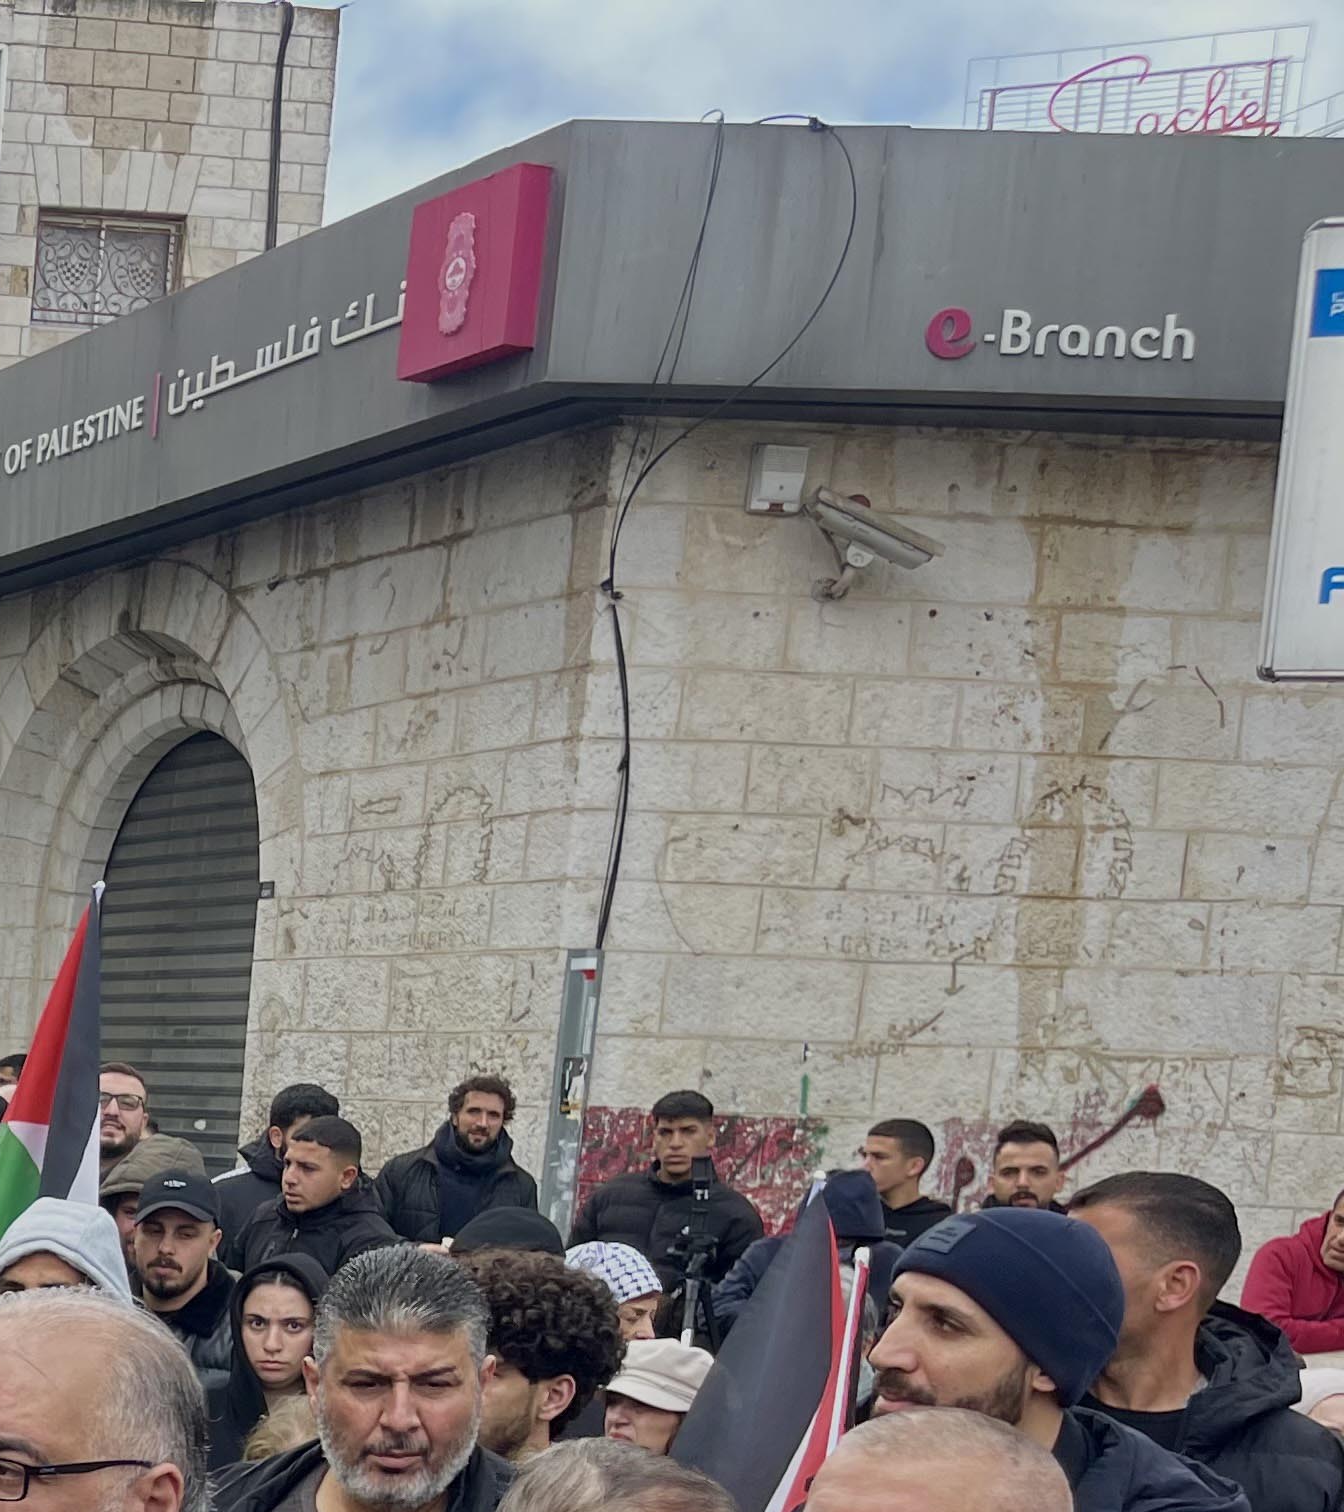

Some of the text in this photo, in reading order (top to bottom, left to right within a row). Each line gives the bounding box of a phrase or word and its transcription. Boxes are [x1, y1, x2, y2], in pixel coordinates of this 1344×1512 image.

[168, 280, 408, 416] نك فلسطين
[924, 307, 1196, 360] e-Branch
[4, 438, 33, 475] OF
[36, 395, 145, 465] PALESTINE
